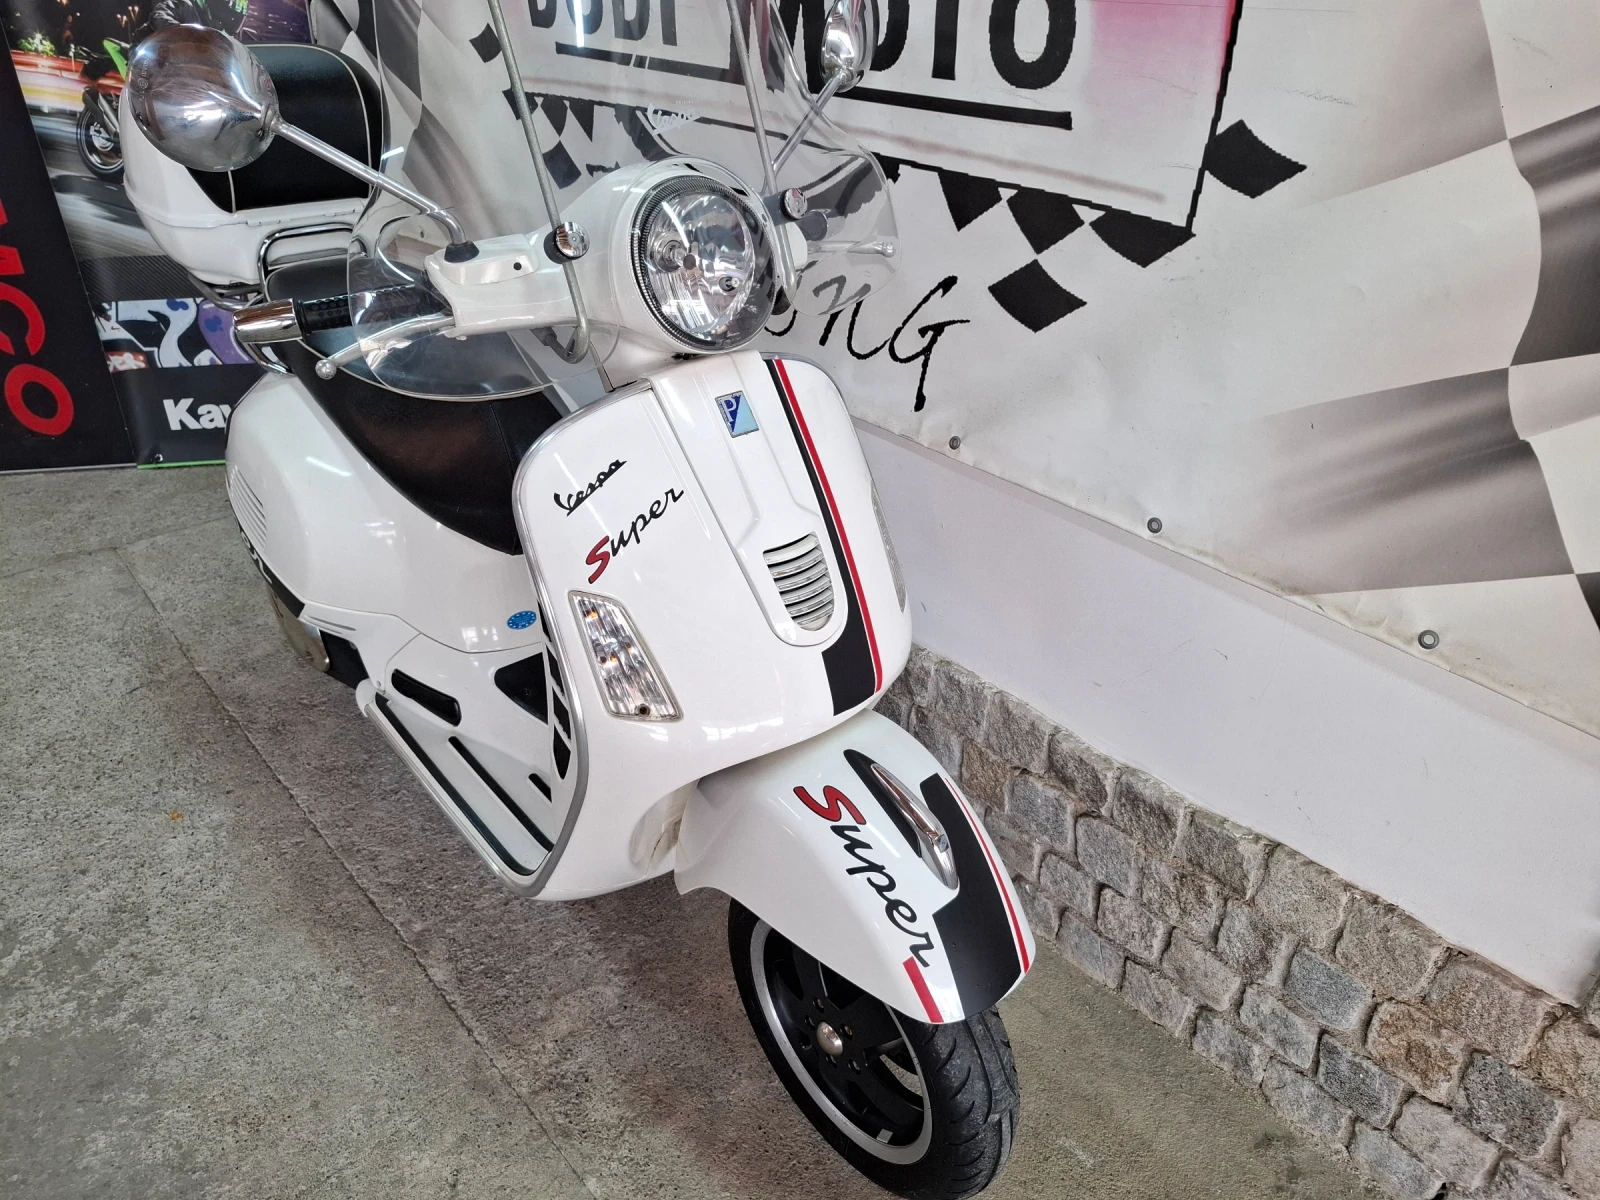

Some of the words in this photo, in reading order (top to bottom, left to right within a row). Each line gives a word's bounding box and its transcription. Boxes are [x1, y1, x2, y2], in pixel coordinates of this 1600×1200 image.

[553, 459, 627, 516] Vespa
[586, 488, 684, 584] Super
[793, 784, 935, 968] Super
